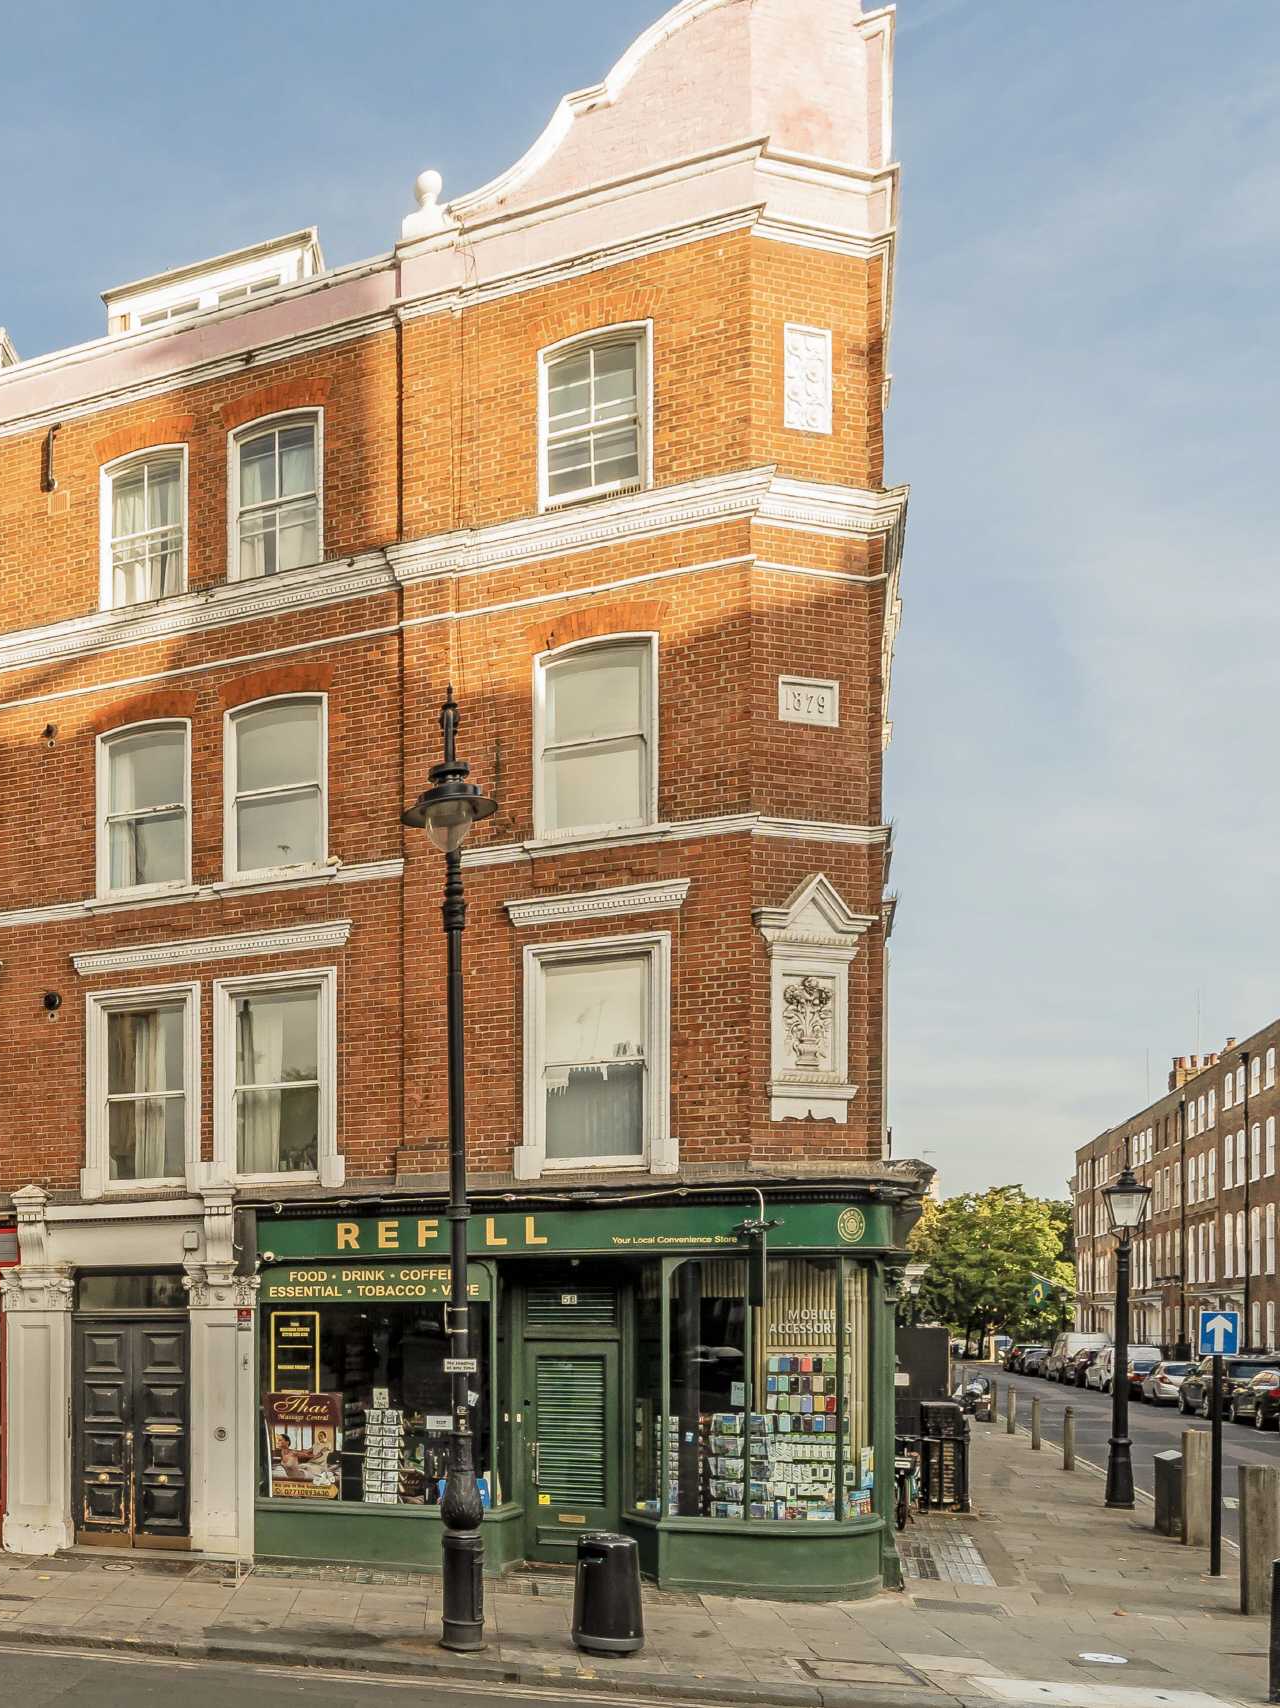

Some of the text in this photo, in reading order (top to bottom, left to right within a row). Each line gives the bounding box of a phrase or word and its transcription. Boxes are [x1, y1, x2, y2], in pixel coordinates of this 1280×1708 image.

[336, 1216, 548, 1249] REFLL
[612, 1235, 738, 1245] Your Local Convenience Store
[289, 1270, 328, 1282] FOOD
[342, 1270, 385, 1282] DRINK
[269, 1284, 480, 1297] ESSENTIAL TOBACCO VE
[788, 1309, 836, 1320] MOBILE
[770, 1322, 852, 1334] ACCESSORIS
[273, 1395, 329, 1414] Thai
